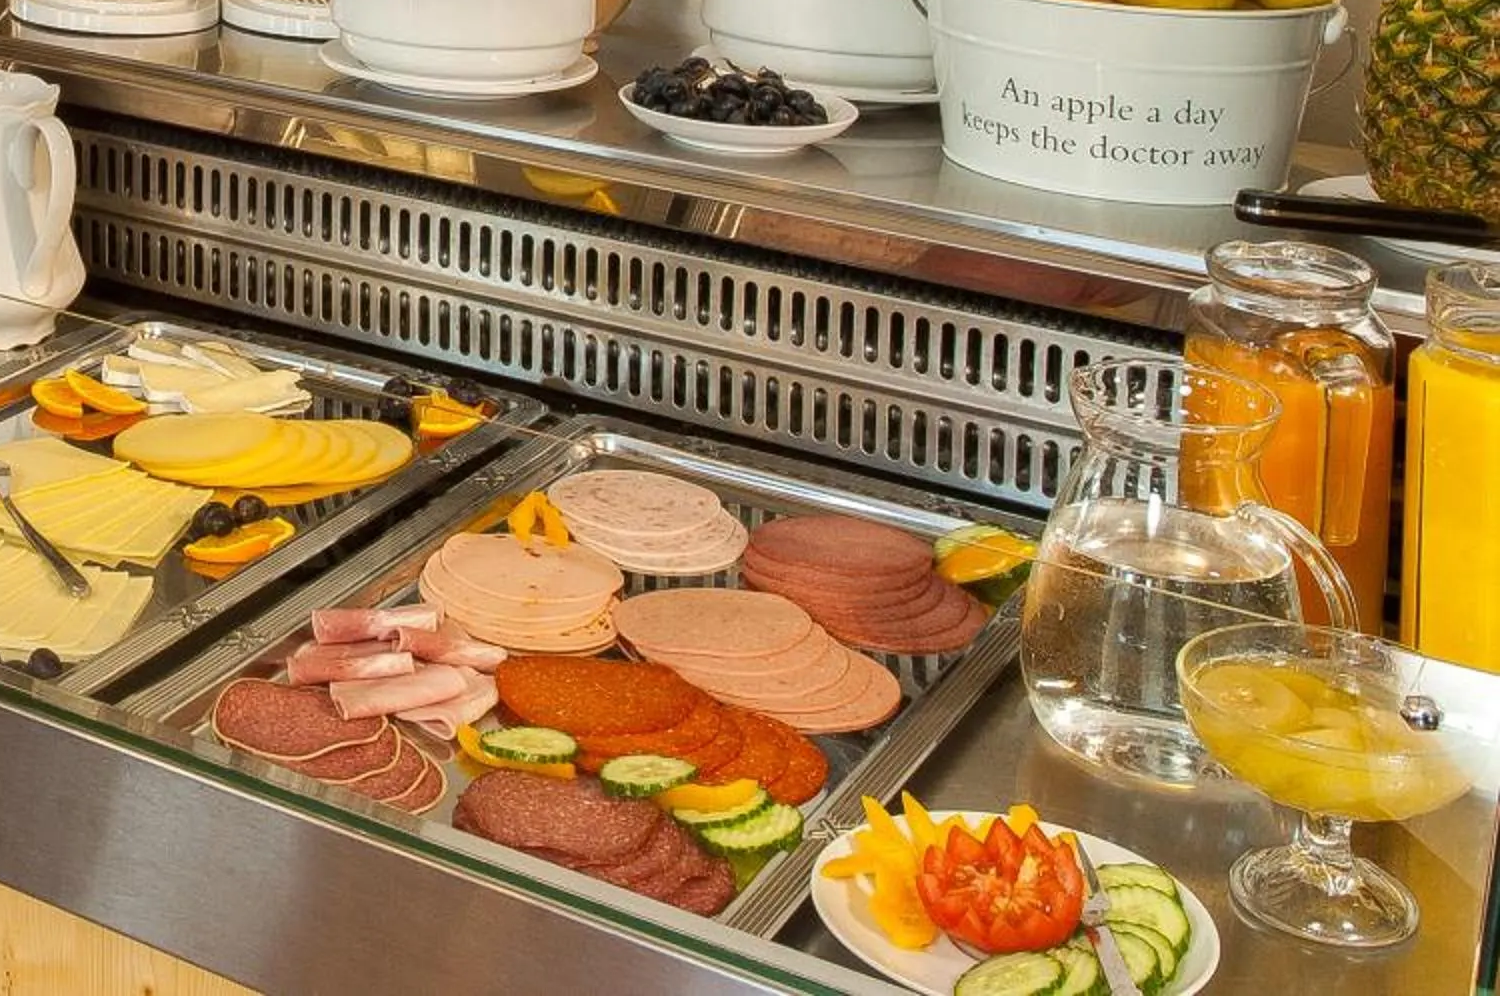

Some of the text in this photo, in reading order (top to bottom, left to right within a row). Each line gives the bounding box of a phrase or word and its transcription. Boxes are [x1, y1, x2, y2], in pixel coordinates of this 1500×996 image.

[1001, 76, 1225, 132] An apple a day
[962, 101, 1265, 170] keeps the doctor away
